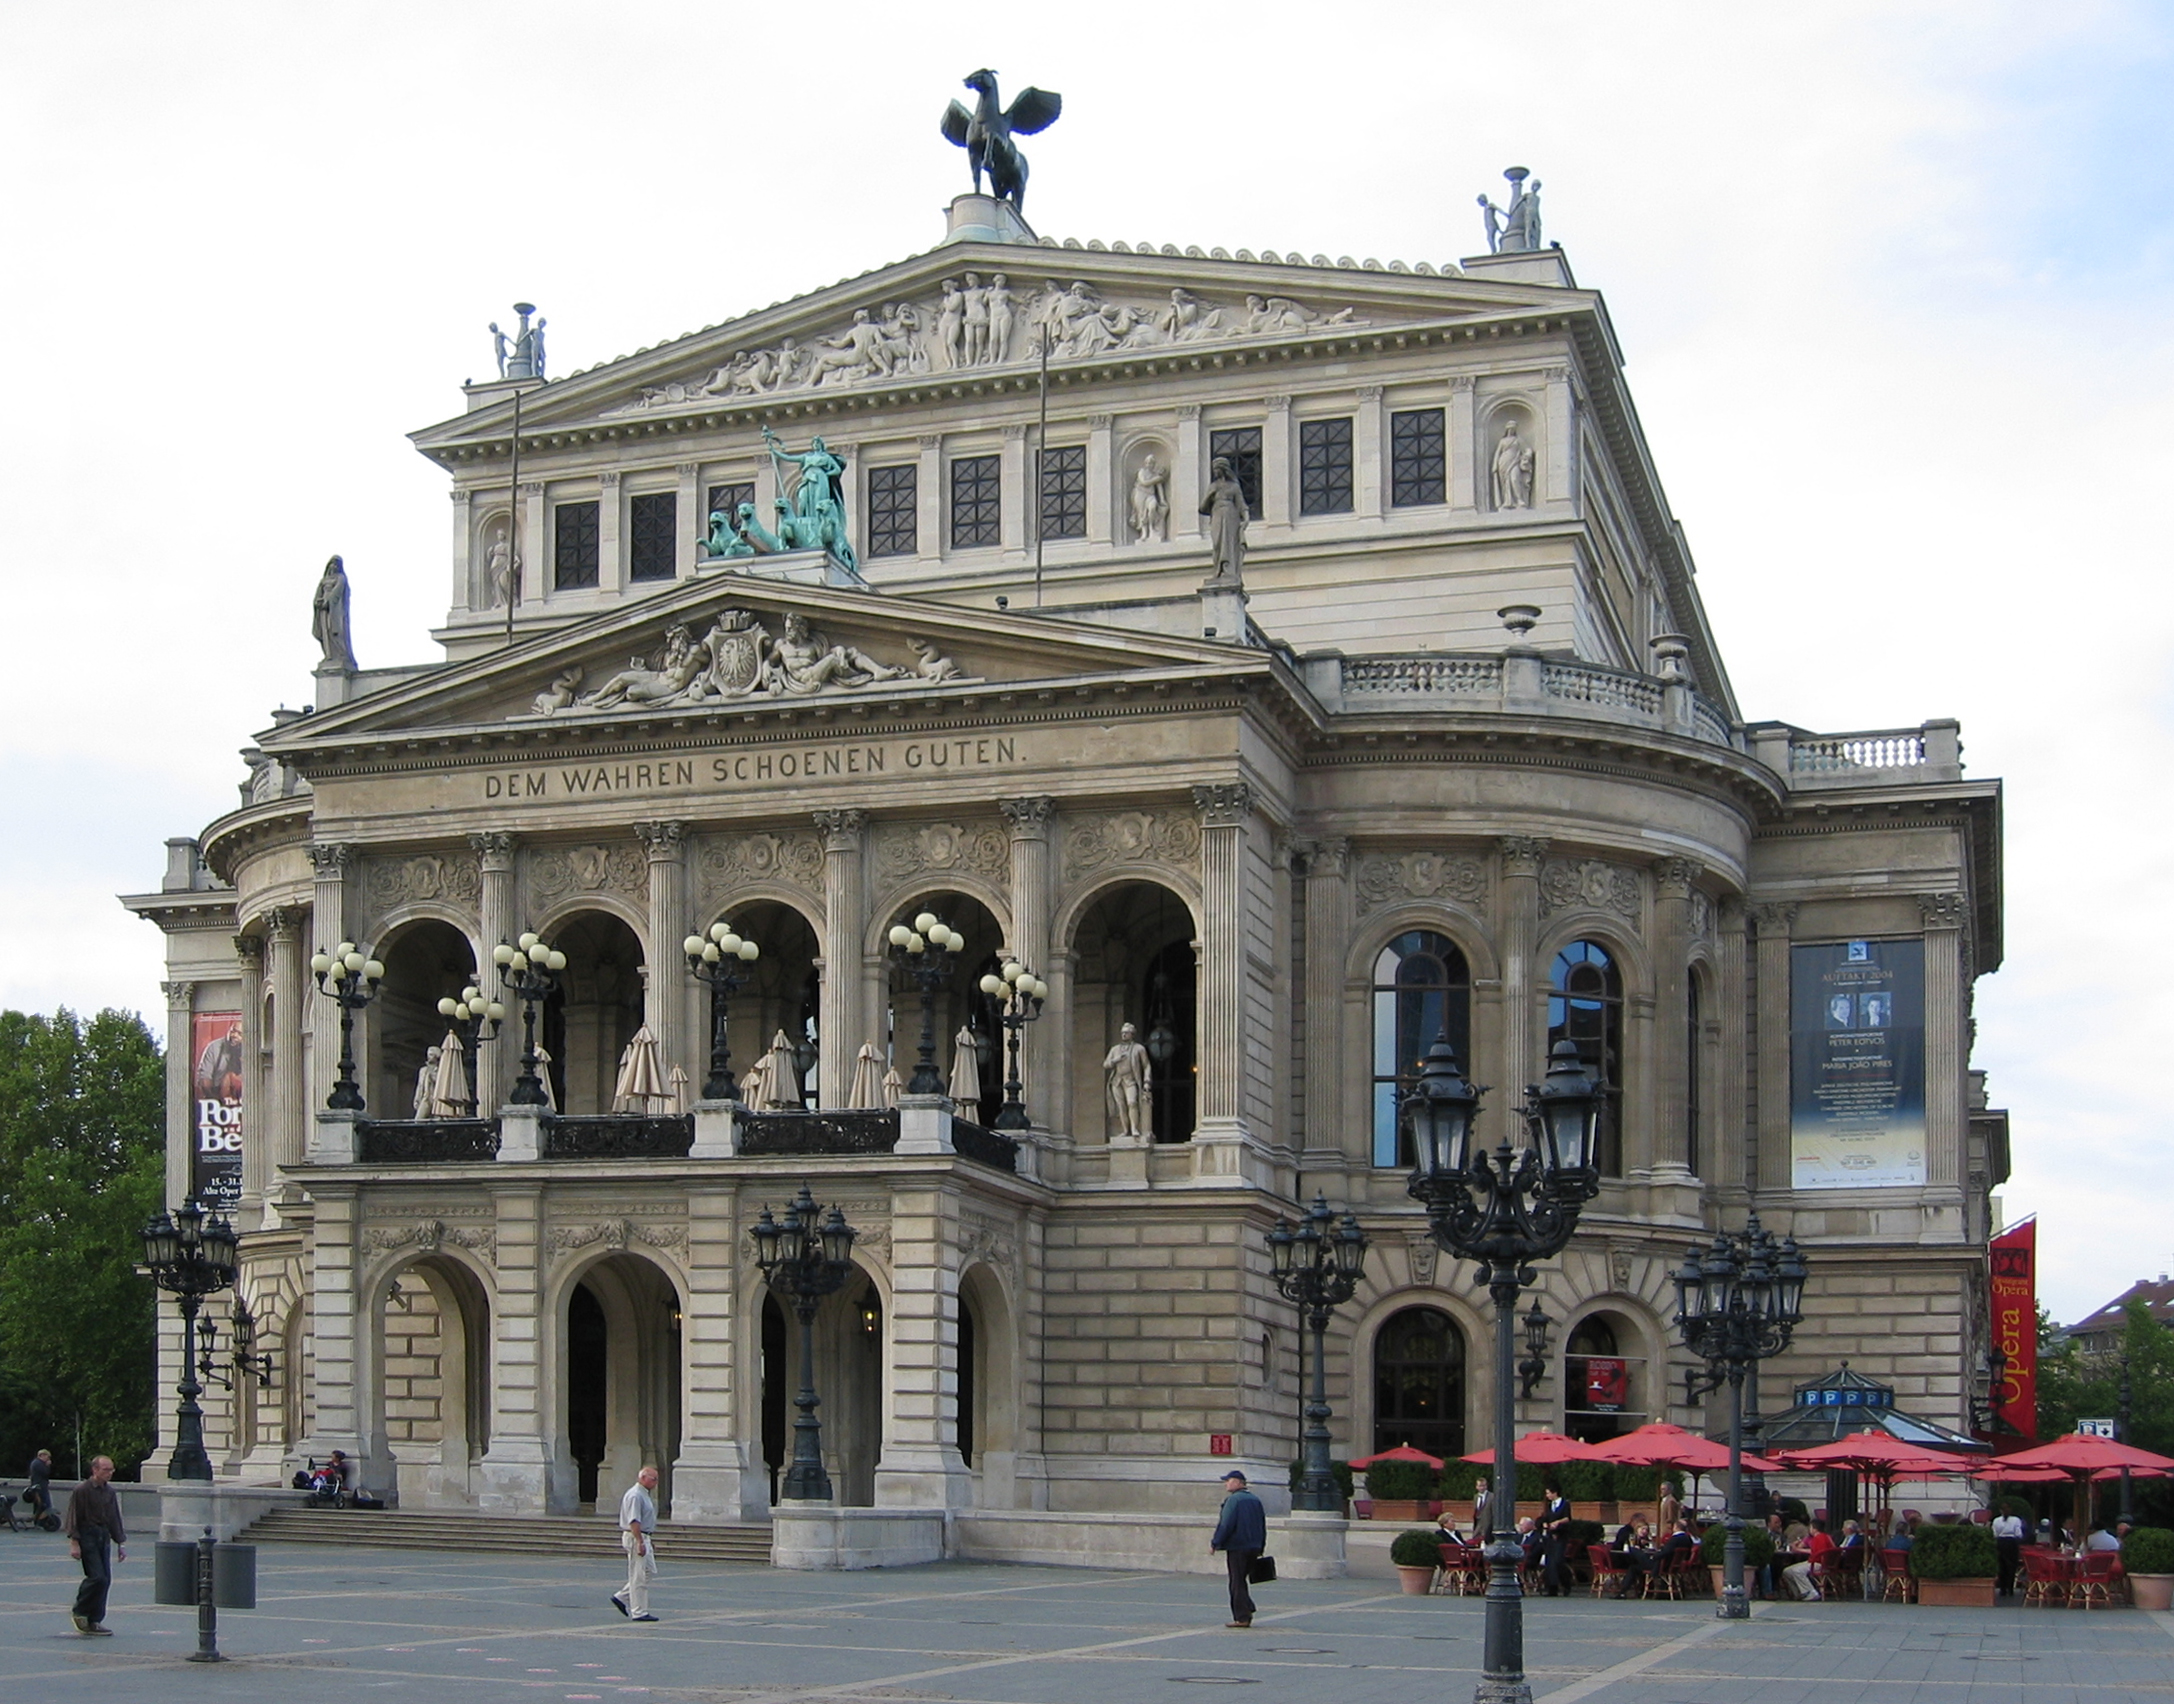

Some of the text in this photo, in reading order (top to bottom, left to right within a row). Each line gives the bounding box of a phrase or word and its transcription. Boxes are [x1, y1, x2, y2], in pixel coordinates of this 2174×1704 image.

[486, 737, 1028, 798] DEM WAHREN SCHOENEN GUTEN.
[1808, 1394, 1816, 1405] P
[1826, 1394, 1836, 1405] P
[1847, 1394, 1857, 1405] P
[1867, 1395, 1877, 1405] P
